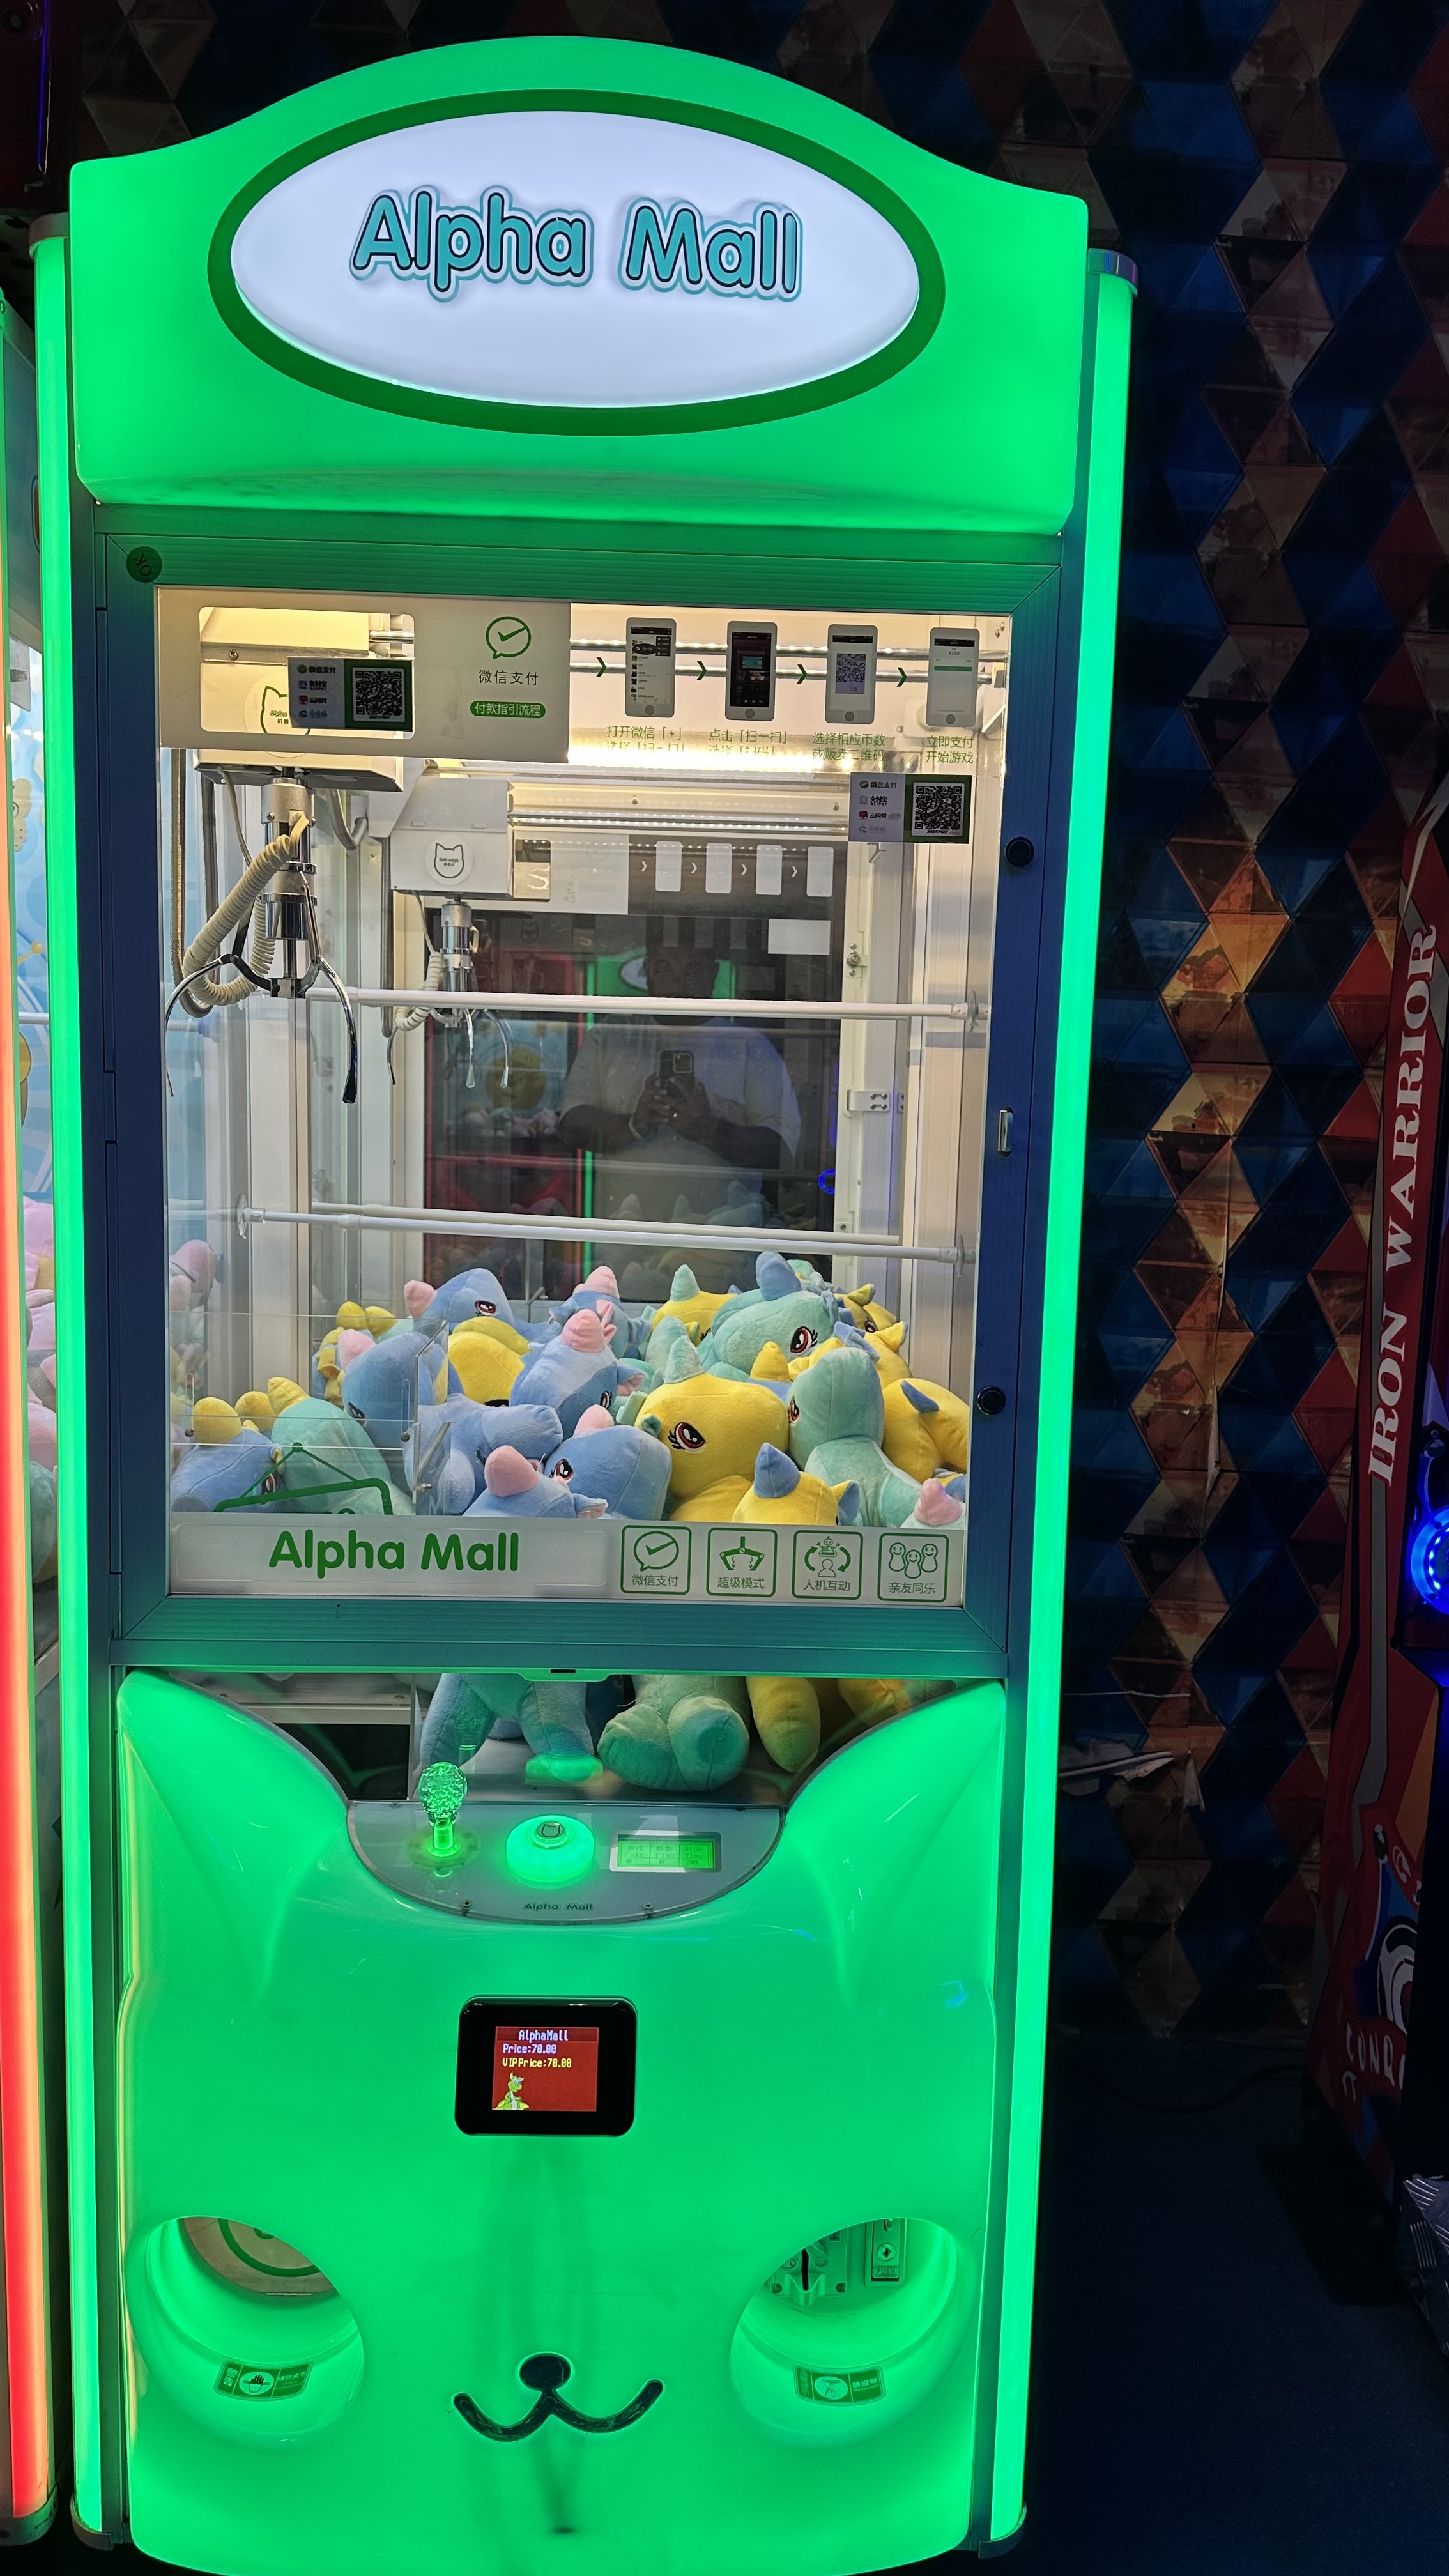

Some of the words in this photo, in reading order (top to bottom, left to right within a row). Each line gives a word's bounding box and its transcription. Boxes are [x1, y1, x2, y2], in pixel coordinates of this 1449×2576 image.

[351, 189, 588, 294] Alpha
[625, 203, 799, 295] Mall
[478, 669, 539, 686] 微信支付
[475, 702, 541, 716] 付款指引流程
[812, 732, 885, 746] 选择相应币数
[925, 735, 974, 749] 立即支付
[925, 751, 974, 764] 开始游戏
[1386, 924, 1437, 1272] WARRIOR
[1368, 1302, 1407, 1487] IRON
[269, 1529, 405, 1579] Alpha
[420, 1532, 519, 1572] Mall
[631, 1574, 679, 1588] 微信支付
[717, 1576, 765, 1591] 超级模式
[802, 1579, 851, 1593] 人机互动
[888, 1581, 936, 1595] 亲友同乐
[524, 1903, 560, 1911] Alpha
[518, 2029, 569, 2043] AlphaMall
[502, 2043, 557, 2054] Price:70.00
